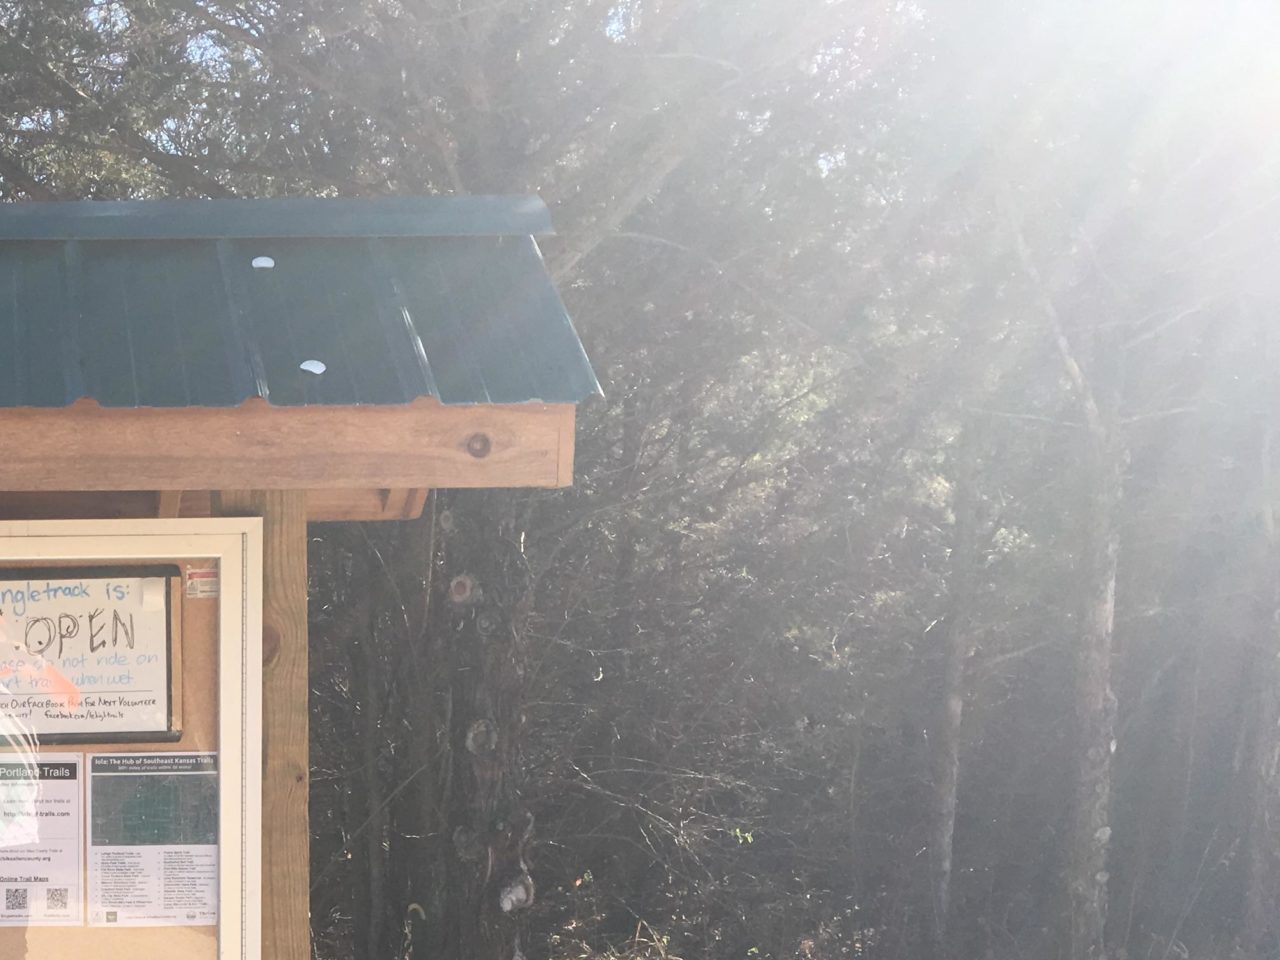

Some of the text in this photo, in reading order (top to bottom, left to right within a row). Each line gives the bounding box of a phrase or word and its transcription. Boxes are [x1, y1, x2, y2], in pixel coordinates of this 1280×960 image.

[106, 582, 129, 601] is:
[24, 607, 135, 659] OPEN
[62, 655, 88, 668] not
[97, 651, 130, 667] ride
[136, 653, 158, 664] on
[43, 767, 71, 777] Trails
